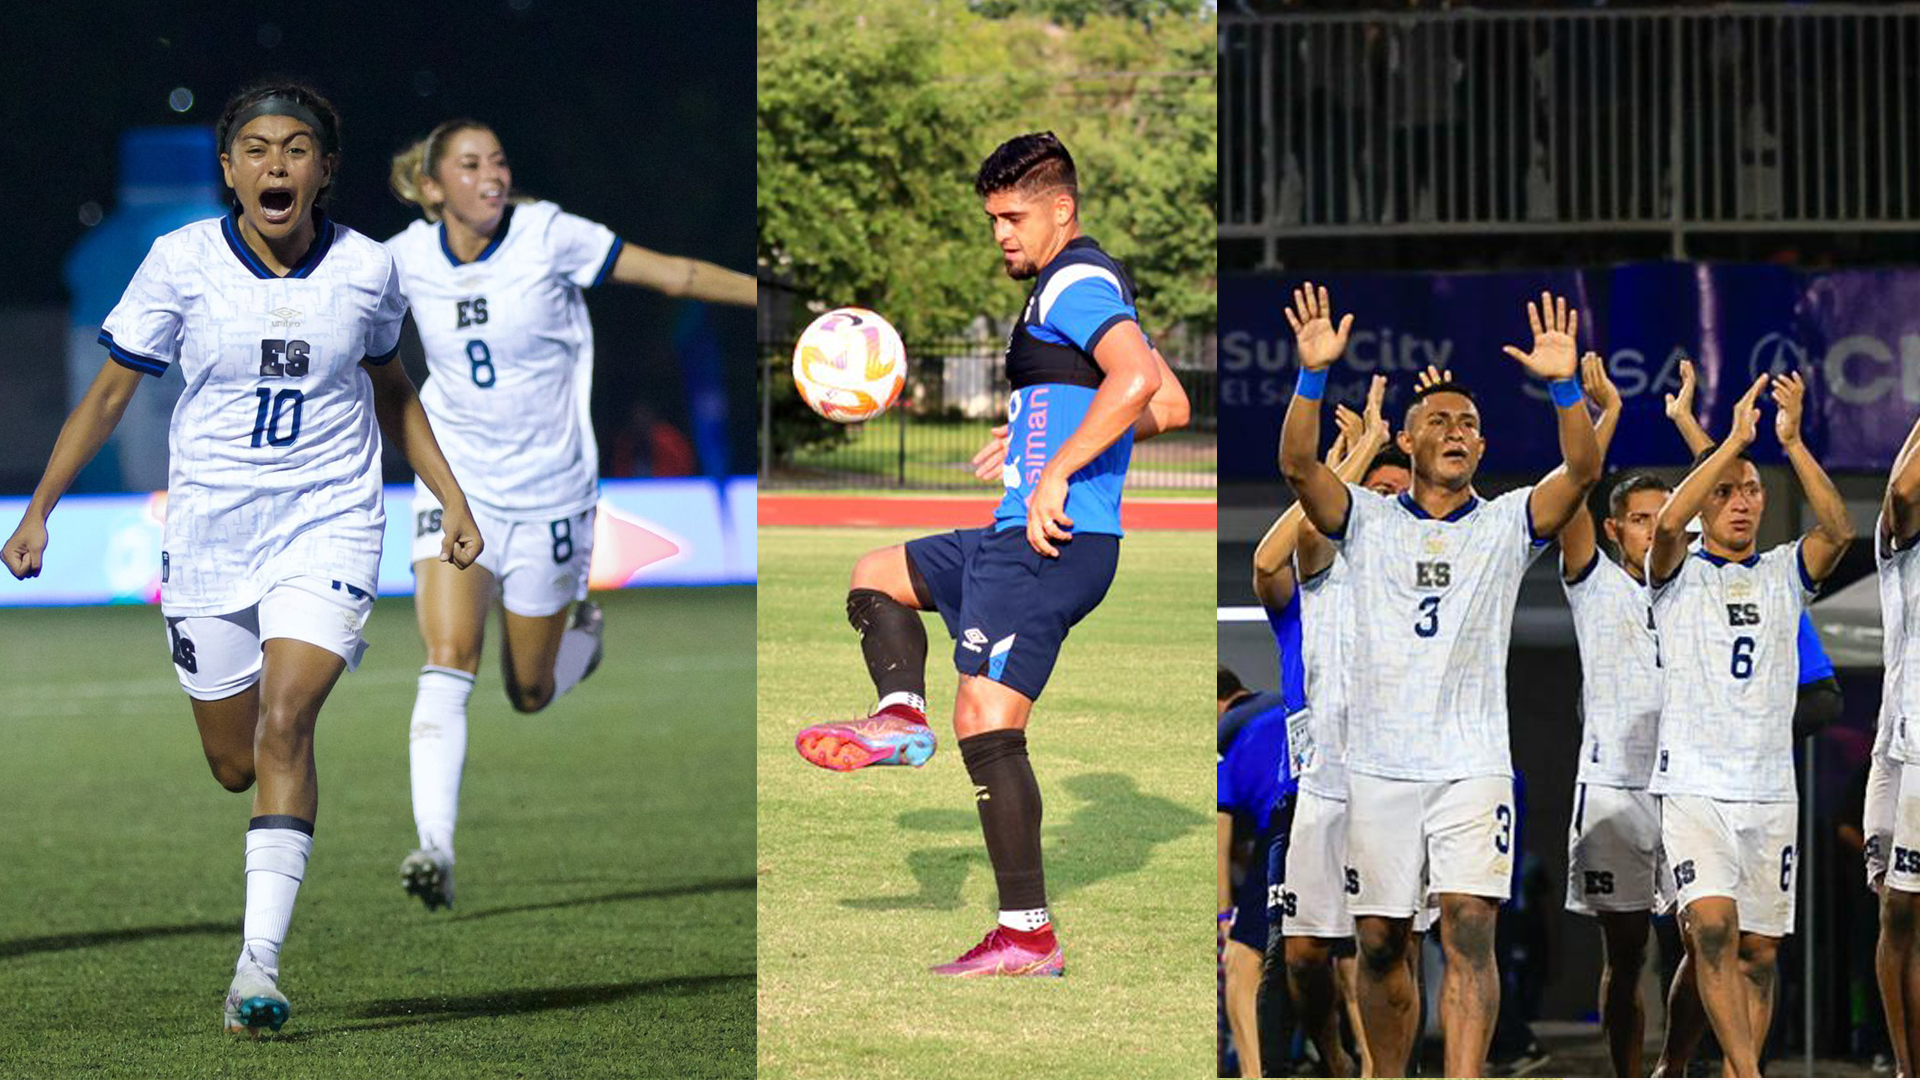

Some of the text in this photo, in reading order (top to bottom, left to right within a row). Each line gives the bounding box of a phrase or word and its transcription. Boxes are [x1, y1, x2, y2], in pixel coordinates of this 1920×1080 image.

[456, 298, 488, 328] ES
[260, 339, 310, 377] ES
[466, 339, 496, 389] 8
[1221, 328, 1453, 373] Su City
[251, 387, 304, 448] 10
[1025, 387, 1049, 486] siman
[552, 518, 573, 564] 8
[1416, 561, 1451, 588] ES
[1414, 596, 1441, 637] 3
[1727, 603, 1760, 626] ES
[1730, 636, 1755, 679] 6
[1495, 804, 1511, 854] 3
[1344, 865, 1360, 895] S
[1780, 845, 1798, 892] 6
[1894, 847, 1920, 874] ES
[1584, 870, 1614, 895] ES
[1283, 889, 1298, 918] S
